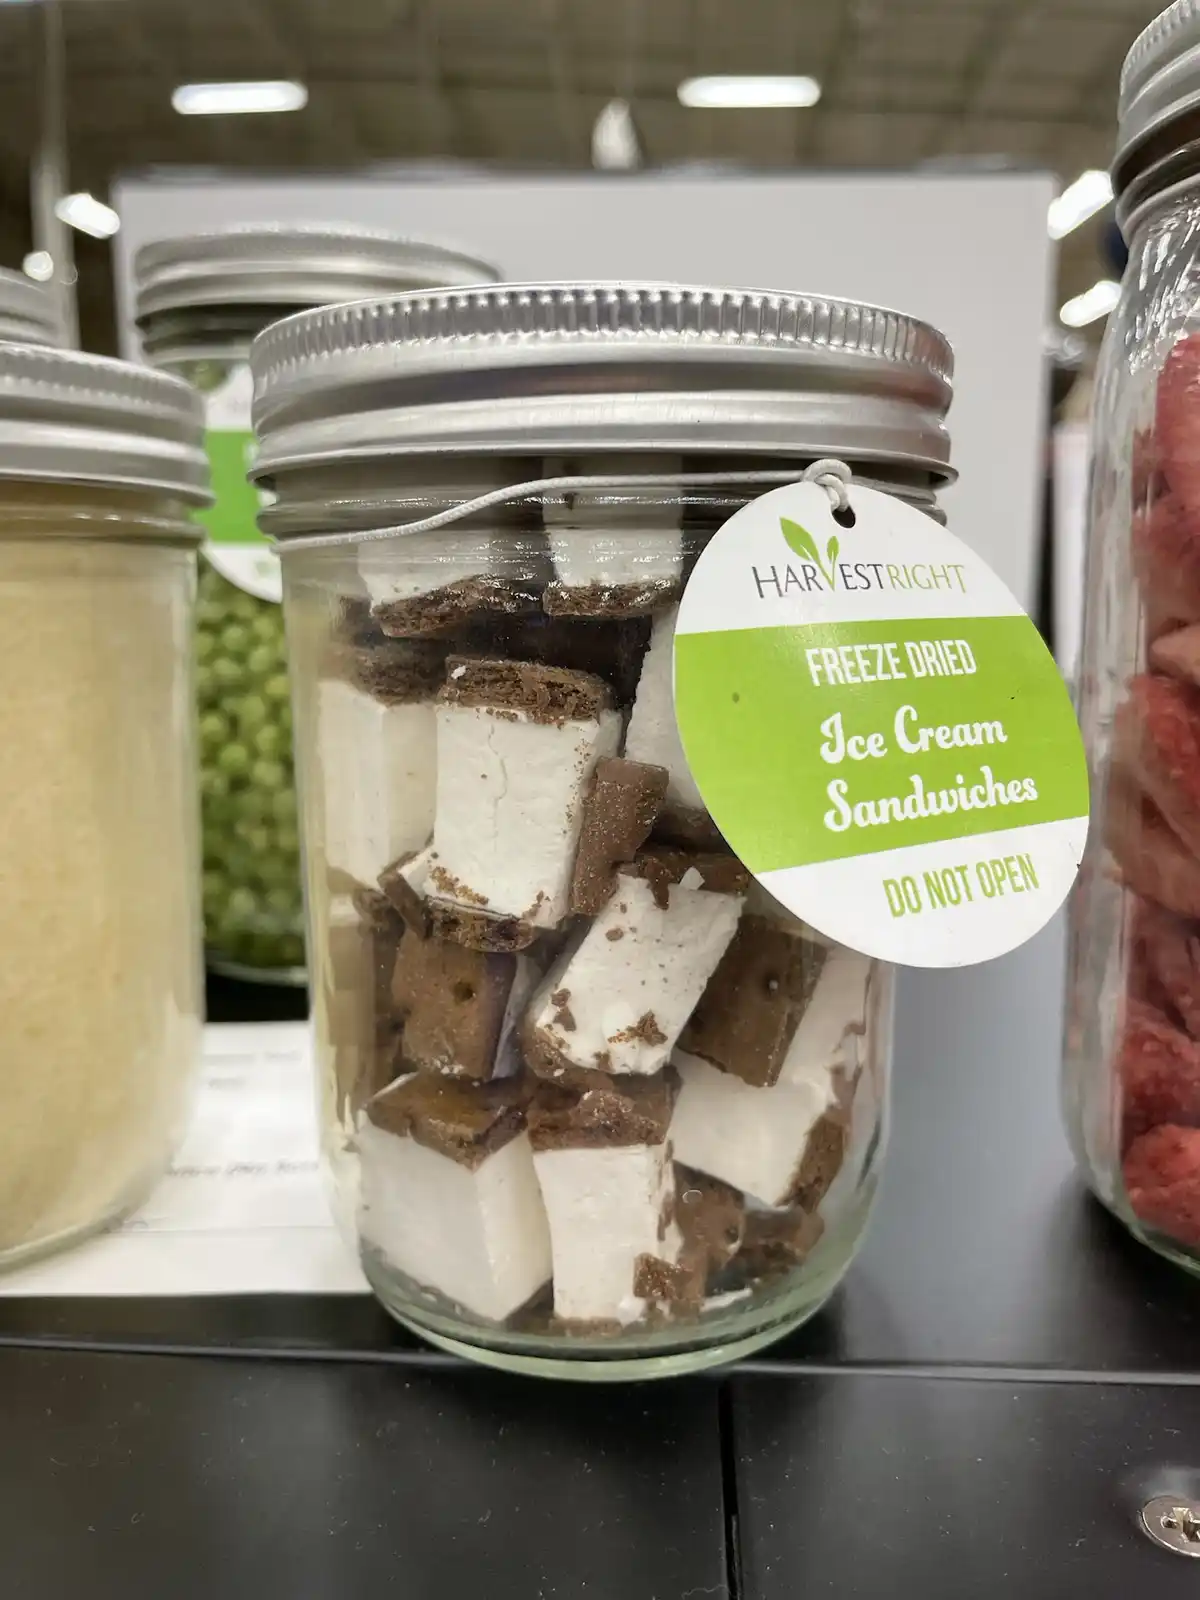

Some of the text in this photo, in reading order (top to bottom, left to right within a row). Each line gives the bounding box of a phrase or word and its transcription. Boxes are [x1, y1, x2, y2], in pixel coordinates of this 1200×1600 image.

[805, 639, 977, 687] FREEZE DRIED
[819, 704, 1008, 764] Ice Cream
[823, 766, 1039, 832] Sandwiches
[882, 852, 1040, 918] DO NOT OPEN
